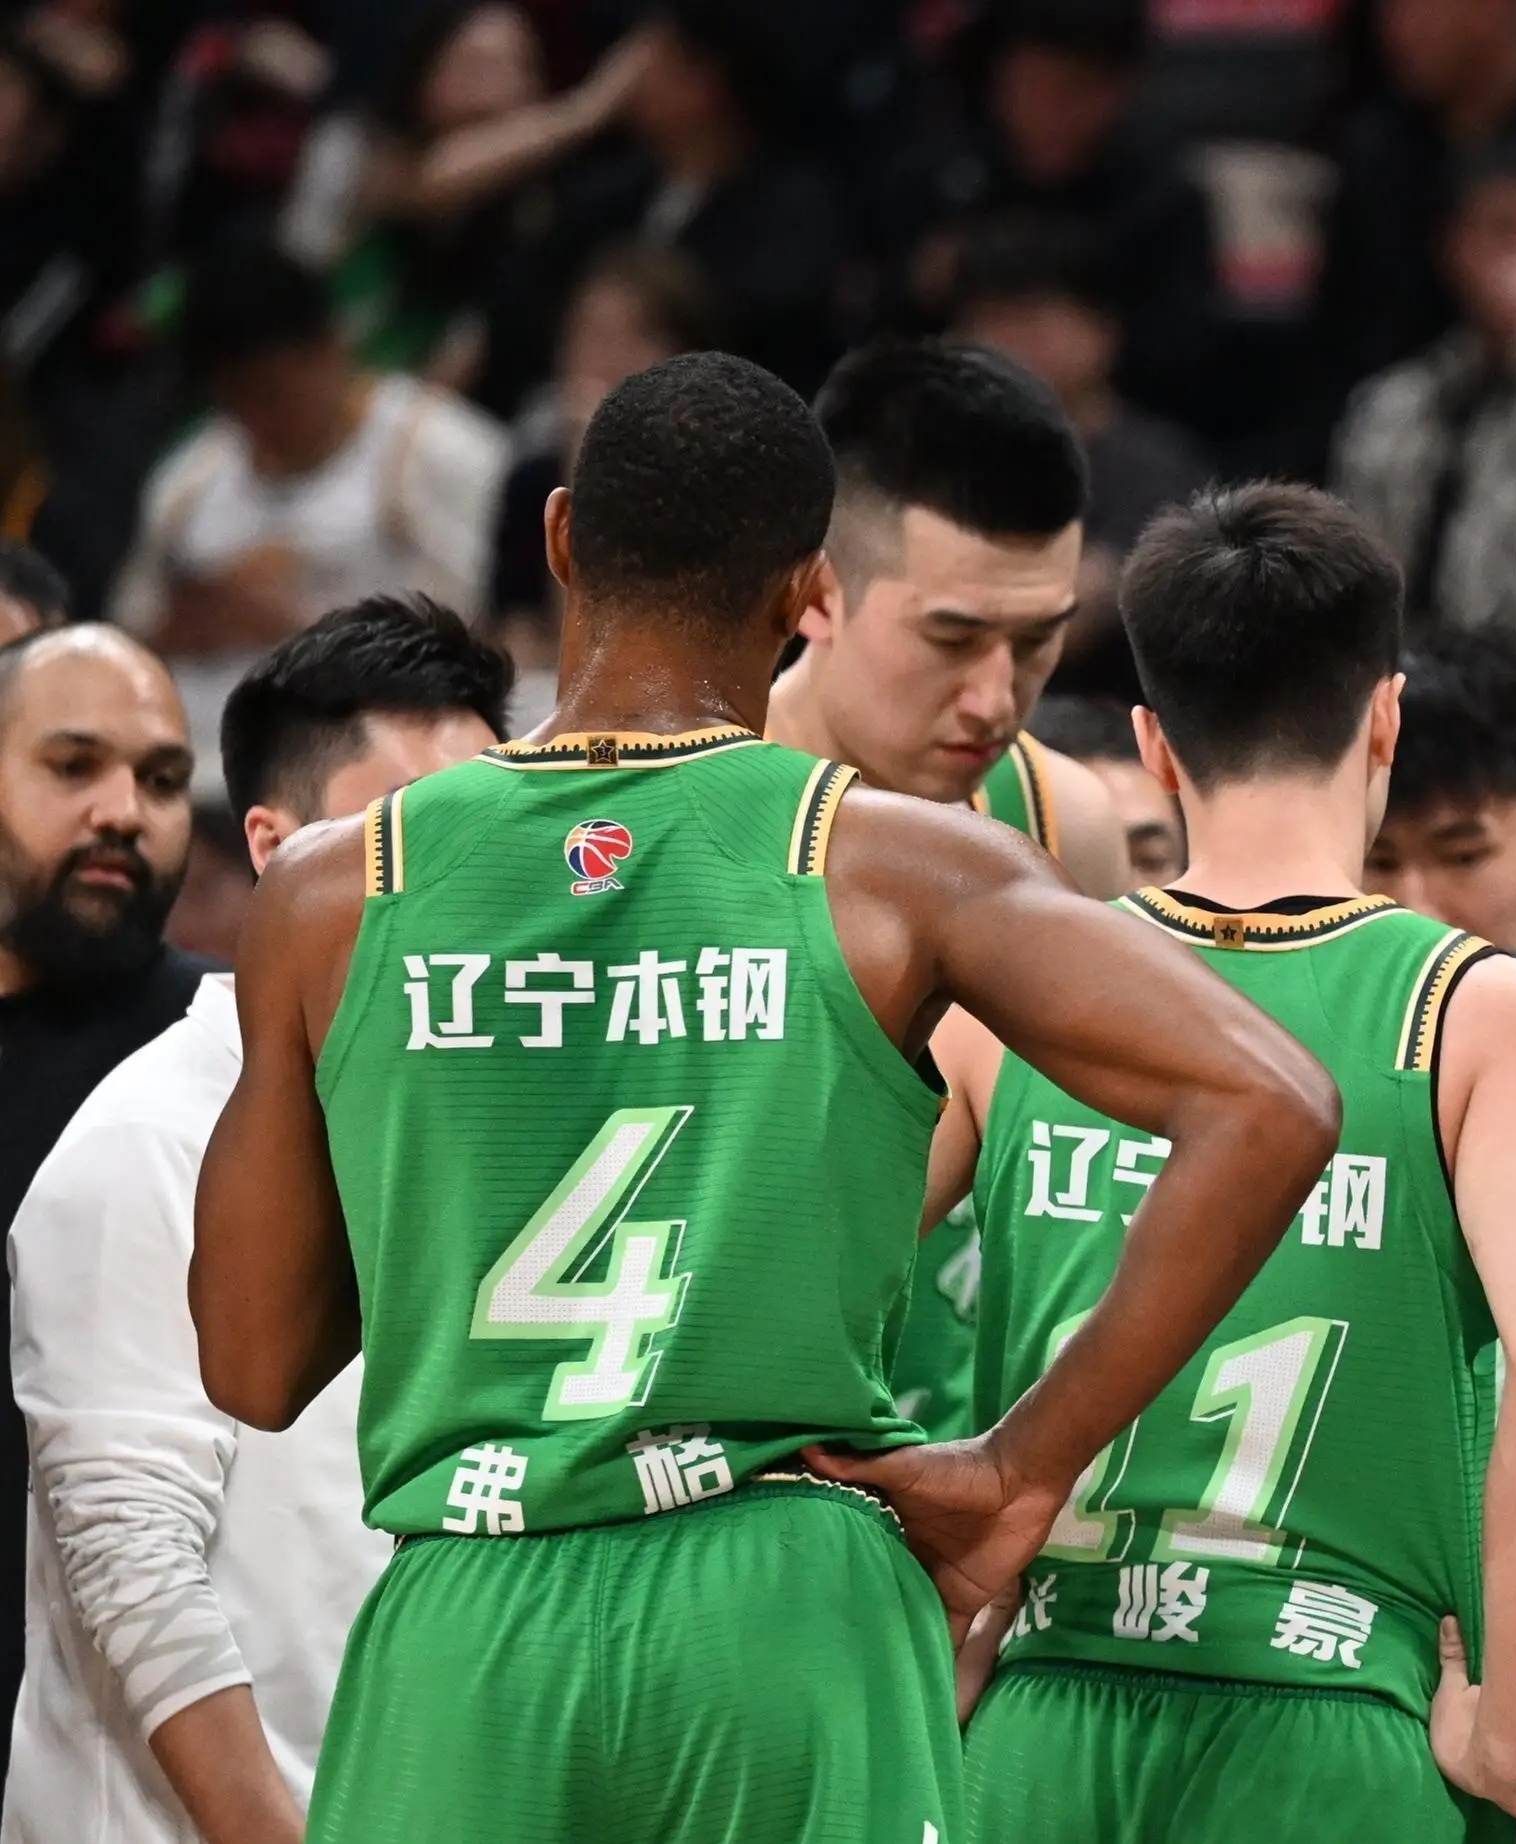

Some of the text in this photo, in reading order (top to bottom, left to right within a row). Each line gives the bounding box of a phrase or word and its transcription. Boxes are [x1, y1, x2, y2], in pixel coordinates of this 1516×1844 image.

[403, 947, 787, 1050] 辽宁本钢
[469, 1105, 694, 1421] 4
[443, 1423, 734, 1536] 弗格
